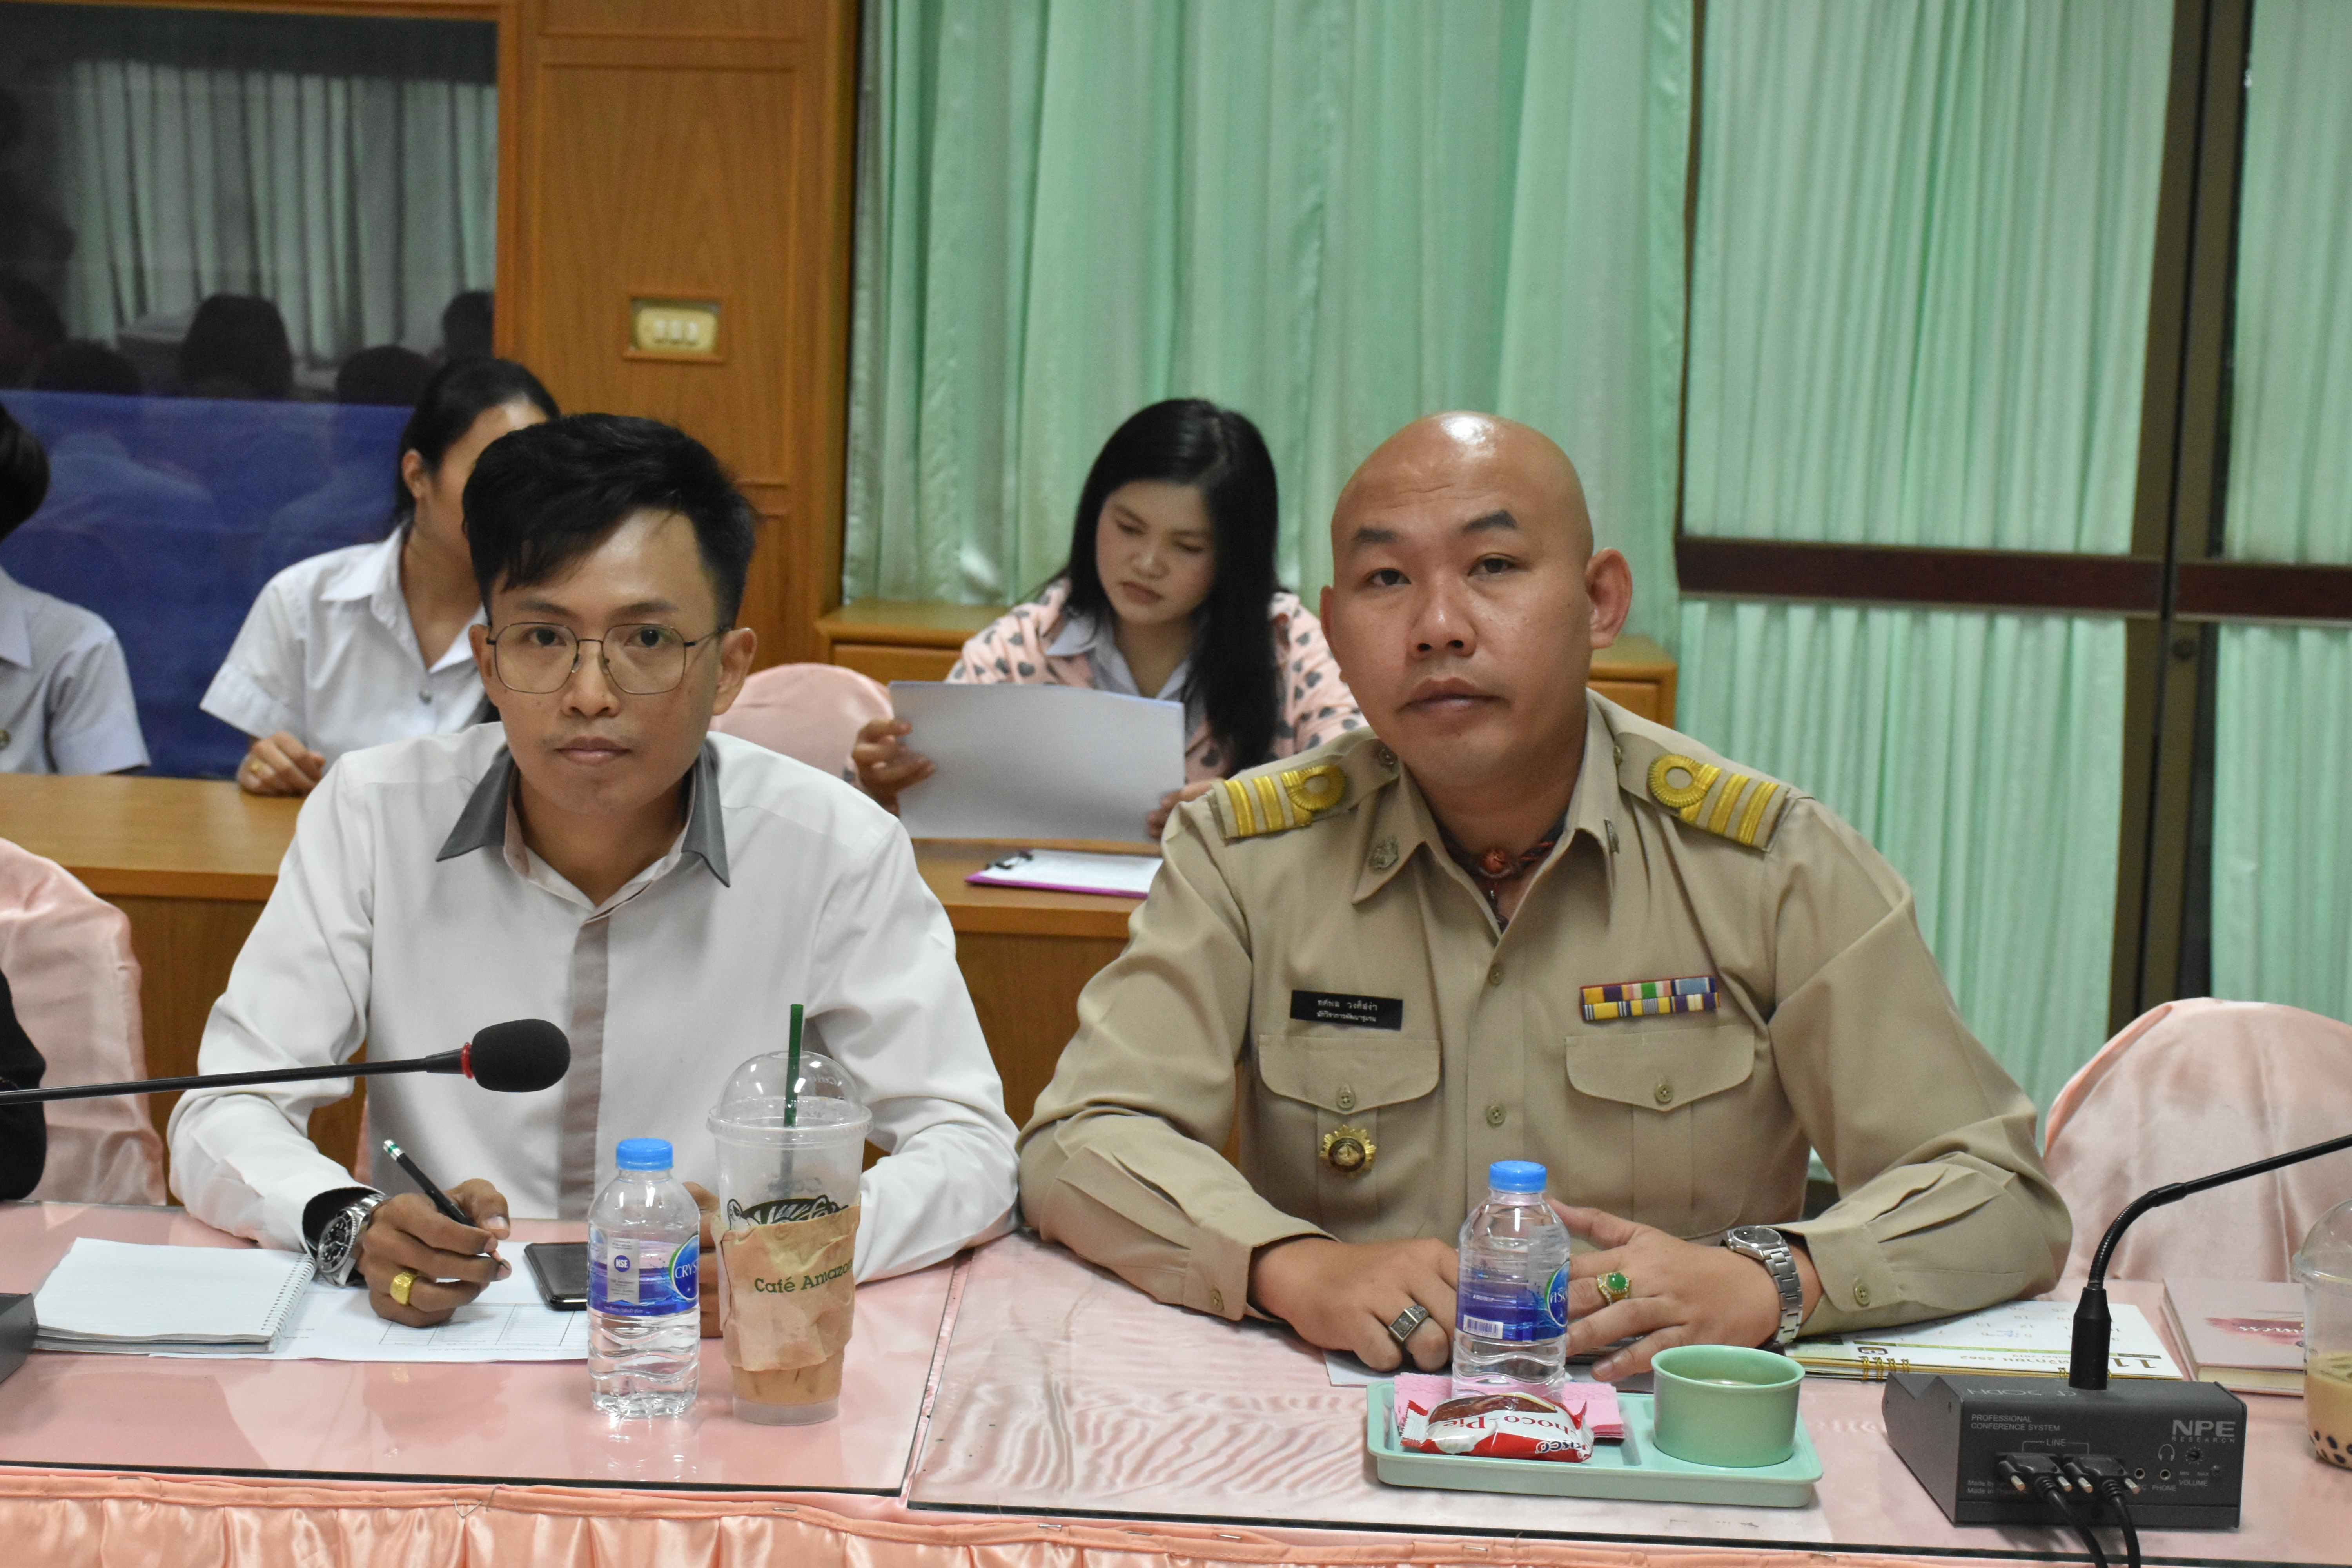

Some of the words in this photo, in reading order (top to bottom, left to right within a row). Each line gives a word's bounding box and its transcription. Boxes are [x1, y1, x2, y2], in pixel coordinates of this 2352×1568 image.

[675, 1258, 699, 1278] CRYS
[754, 1276, 795, 1293] Café
[800, 1258, 853, 1290] Amazon
[2109, 1358, 2157, 1368] 11
[1971, 1414, 2032, 1423] PROFESSIONAL
[2172, 1420, 2235, 1437] NPE
